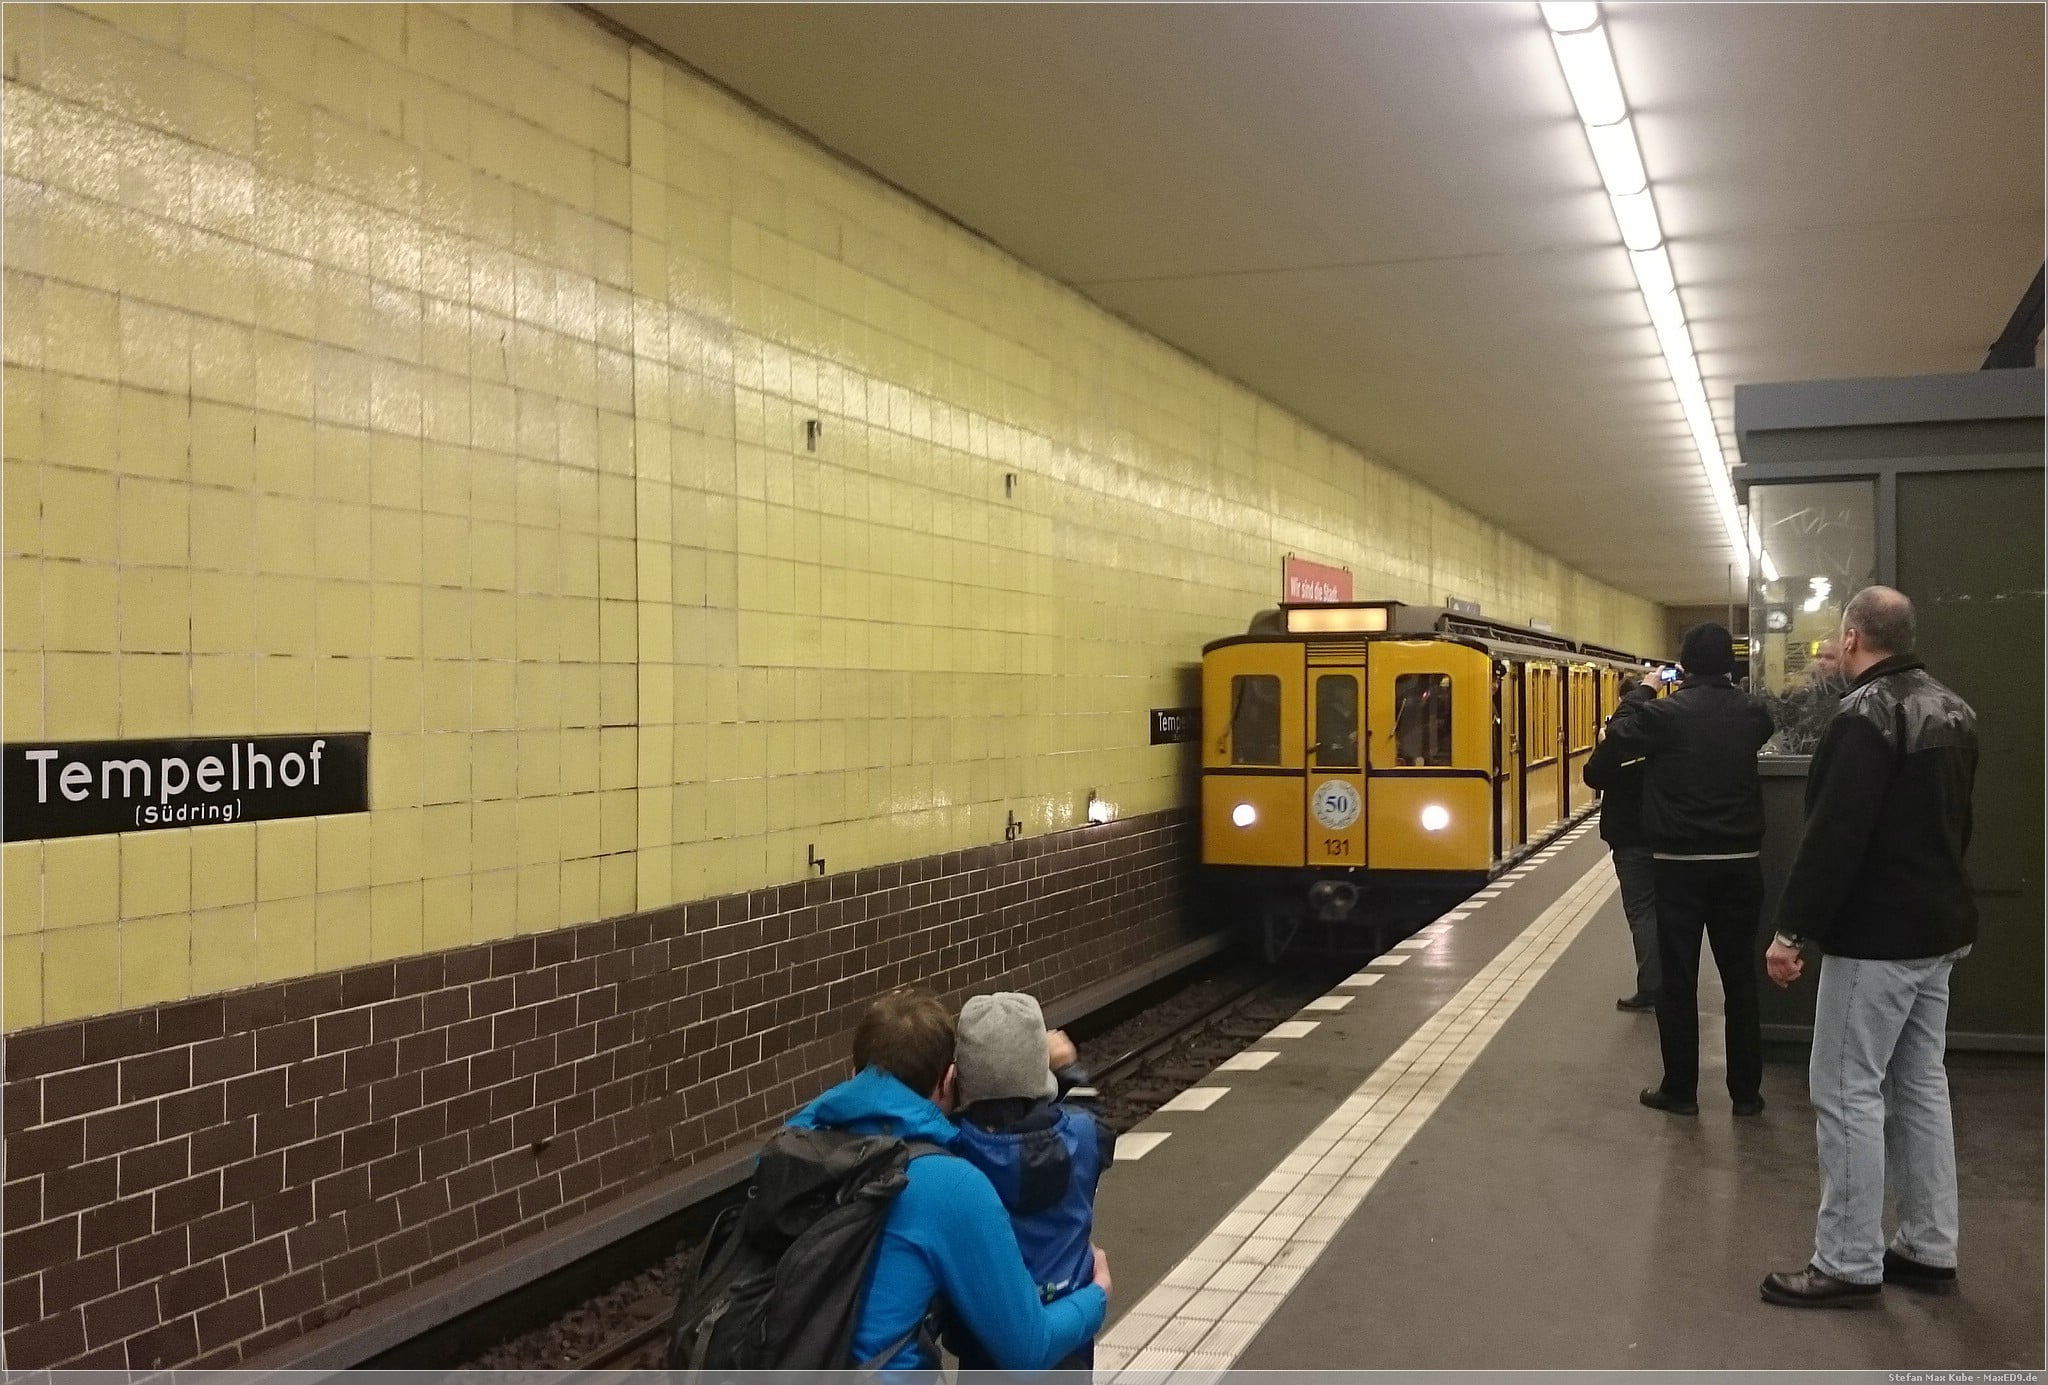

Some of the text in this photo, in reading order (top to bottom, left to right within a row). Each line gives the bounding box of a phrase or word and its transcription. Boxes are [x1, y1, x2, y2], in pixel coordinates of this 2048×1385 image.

[1290, 575, 1301, 598] Wir
[1301, 578, 1314, 600] sind
[1314, 581, 1323, 602] die
[25, 740, 326, 804] Tempelhof
[135, 798, 241, 827] (Südring)
[1325, 795, 1348, 813] 50
[1323, 838, 1350, 856] 131
